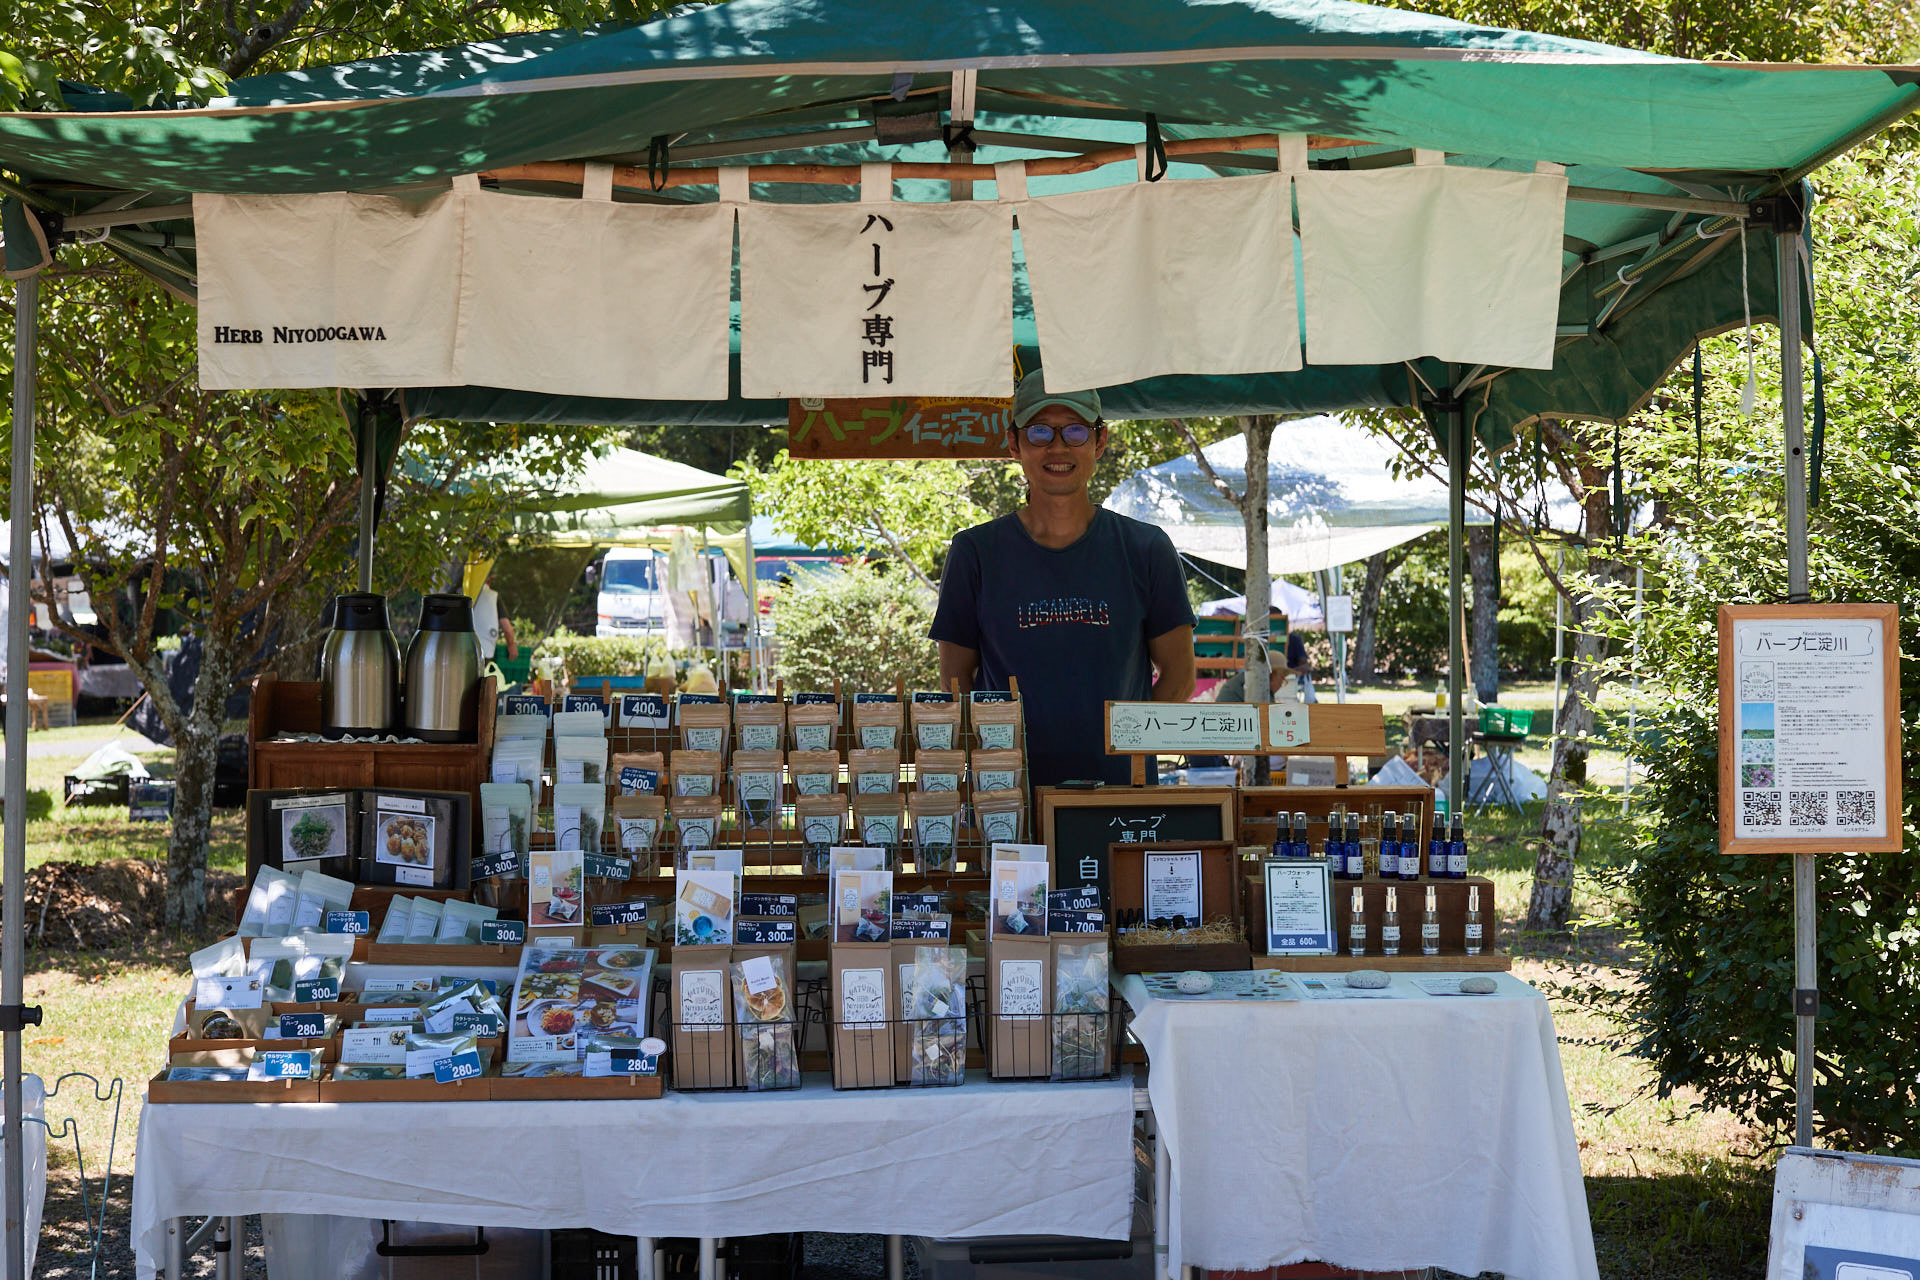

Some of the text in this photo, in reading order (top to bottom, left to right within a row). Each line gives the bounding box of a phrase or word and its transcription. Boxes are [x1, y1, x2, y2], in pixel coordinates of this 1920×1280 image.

[860, 214, 895, 384] ハーブ専門
[1756, 637, 1848, 651] ハーブ仁淀川
[632, 702, 661, 715] 400円
[1144, 716, 1253, 732] ハーブ仁淀川
[1109, 813, 1167, 829] ハーブ
[1119, 830, 1158, 843] 専門
[1079, 856, 1099, 886] 自
[1281, 938, 1296, 946] 全品
